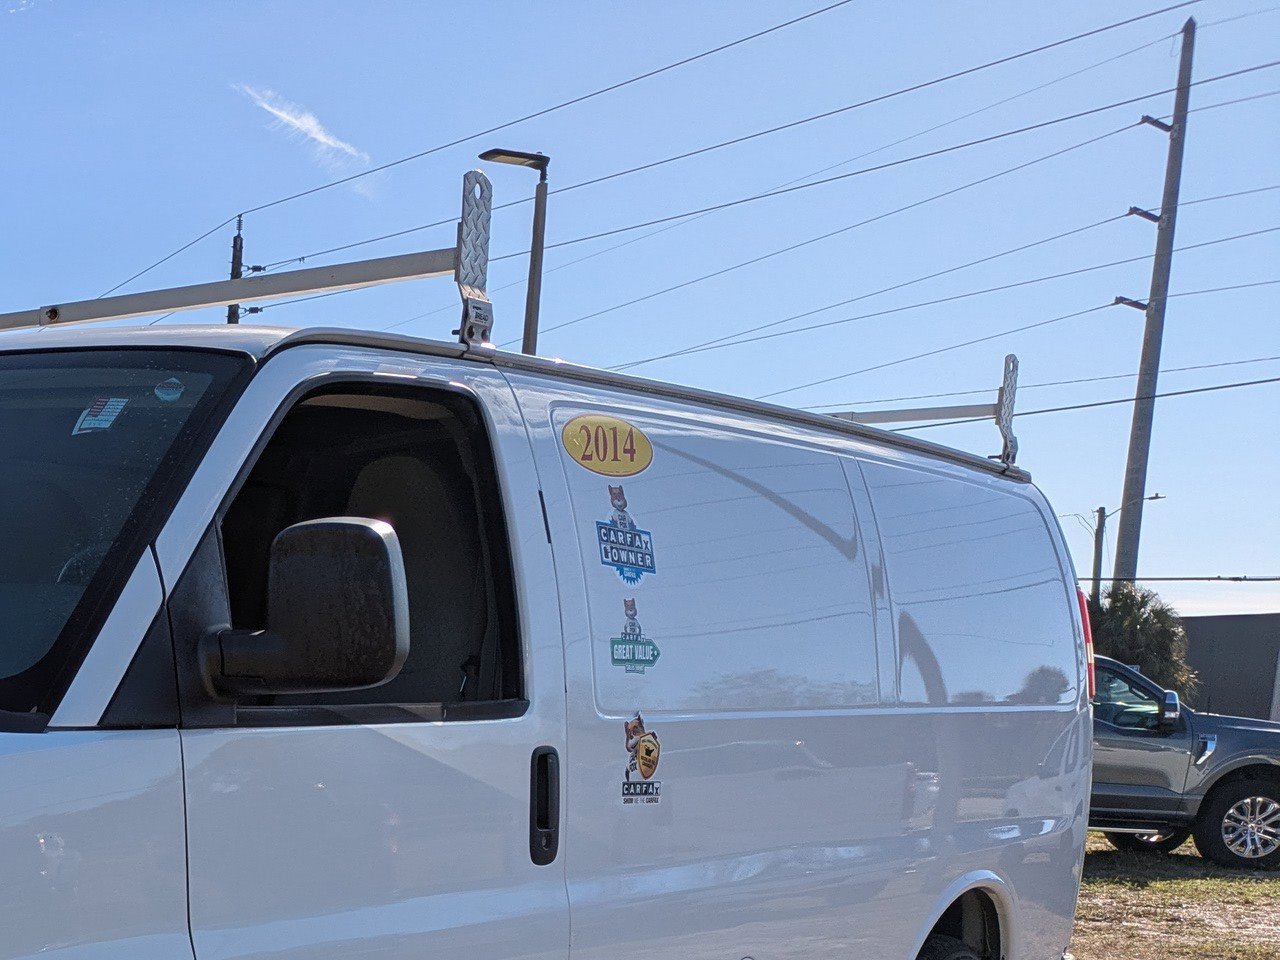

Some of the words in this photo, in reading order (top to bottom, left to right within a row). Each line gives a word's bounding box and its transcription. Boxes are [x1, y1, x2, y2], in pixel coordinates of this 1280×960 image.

[579, 425, 636, 462] 2014
[600, 528, 650, 551] CARFAX
[613, 645, 633, 659] GREAT
[635, 645, 653, 660] VALUE
[623, 784, 660, 795] CARFAX
